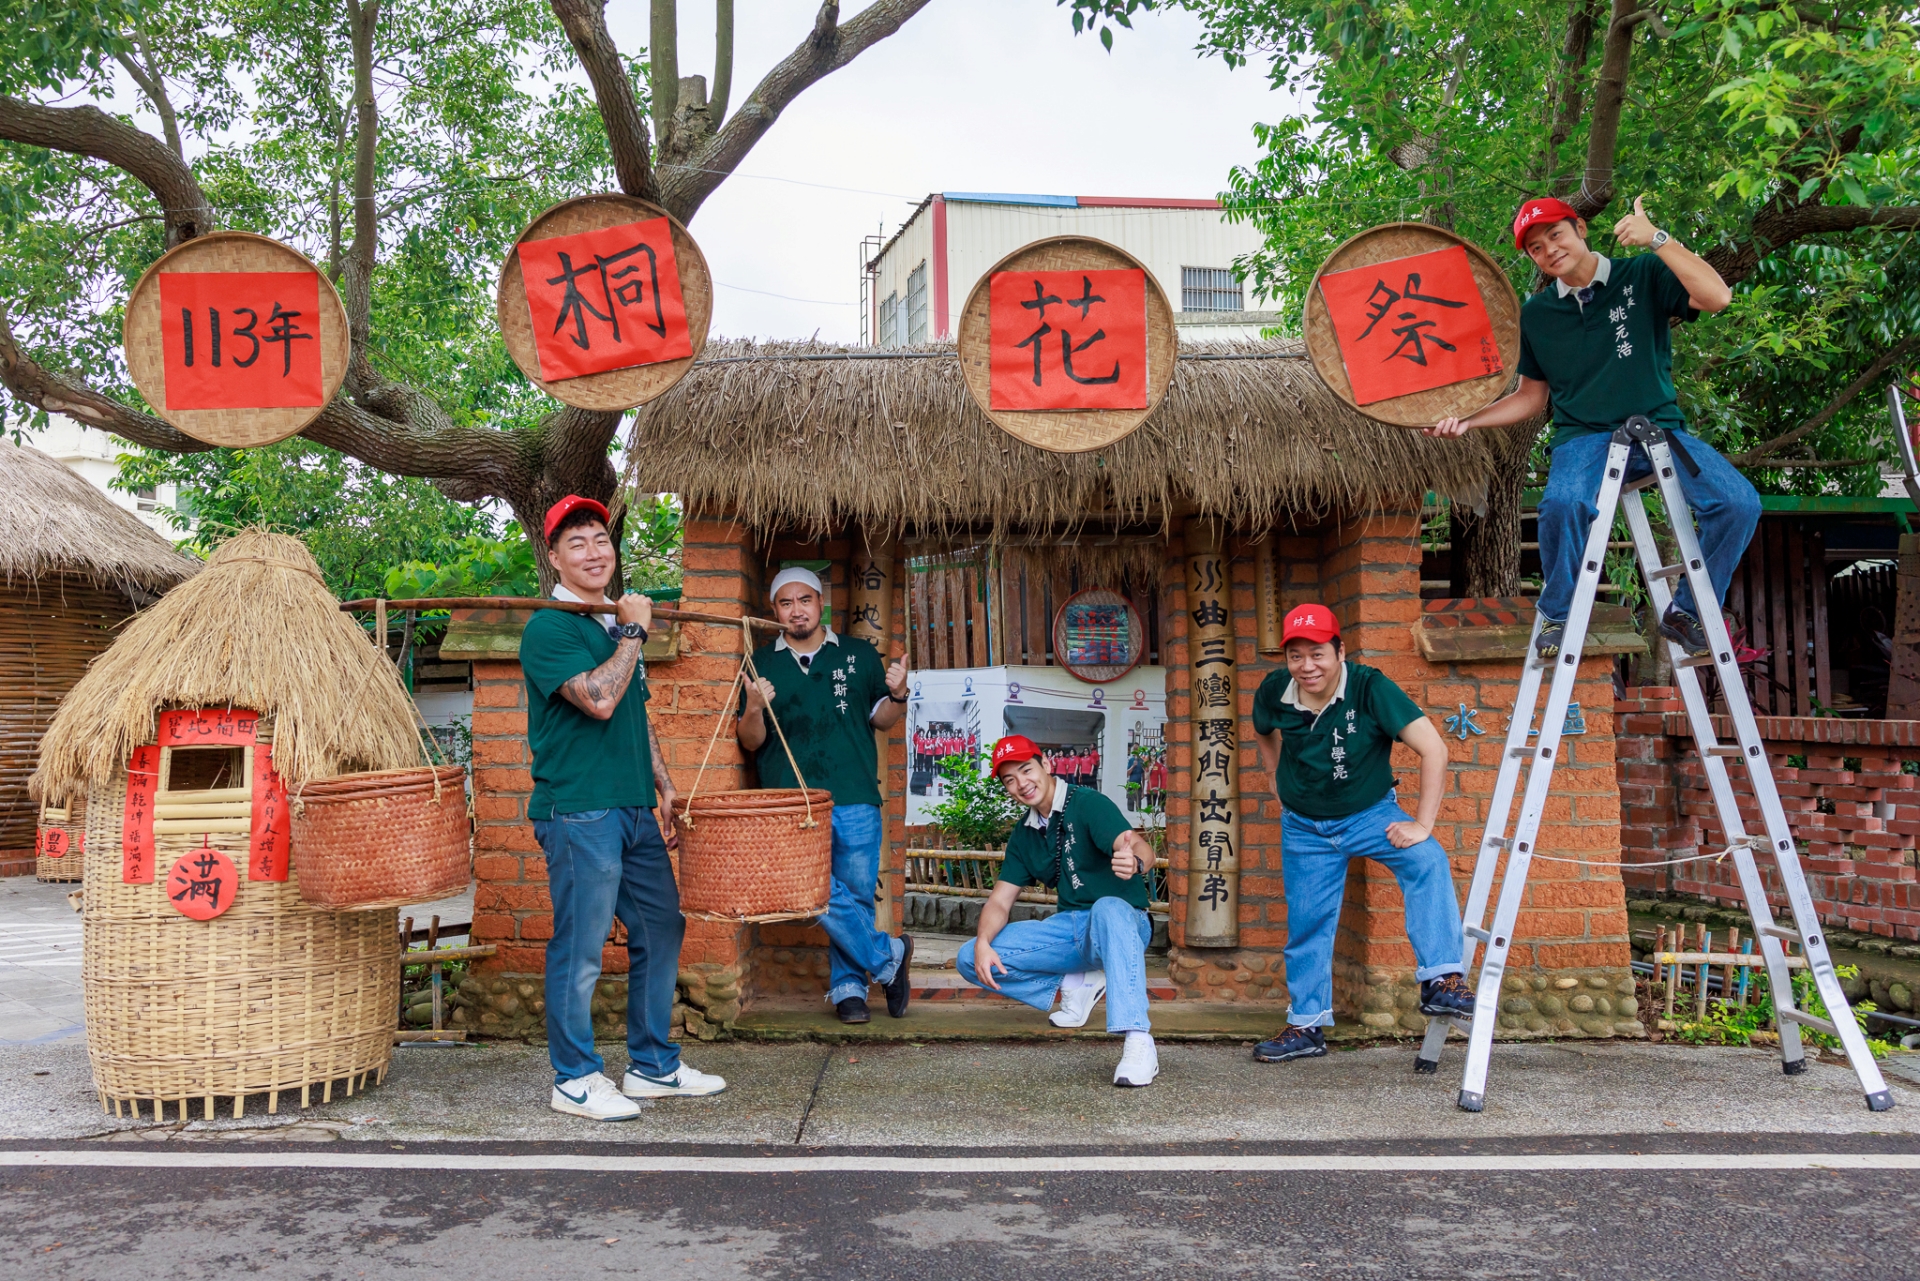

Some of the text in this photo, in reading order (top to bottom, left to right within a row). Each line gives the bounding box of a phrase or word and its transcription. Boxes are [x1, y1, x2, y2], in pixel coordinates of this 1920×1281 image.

[1520, 206, 1543, 226] 村長
[546, 242, 667, 350] 桐
[1355, 272, 1468, 367] 祭
[1622, 284, 1636, 309] 村長
[181, 301, 313, 378] 113年
[1014, 275, 1121, 387] 花
[1608, 305, 1633, 358] 姚元浩
[1293, 614, 1316, 627] 村長
[846, 655, 856, 674] 村長
[832, 668, 848, 714] 瑪斯卡
[1345, 708, 1357, 734] 村長
[1445, 702, 1587, 740] 水區
[996, 742, 1016, 759] 村長
[1331, 727, 1348, 781] 卜學亮
[128, 751, 150, 881] 春滿乾坤福滿堂
[1067, 822, 1077, 844] 村長
[172, 853, 222, 909] 滿
[1064, 839, 1085, 890] 禾浩辰
